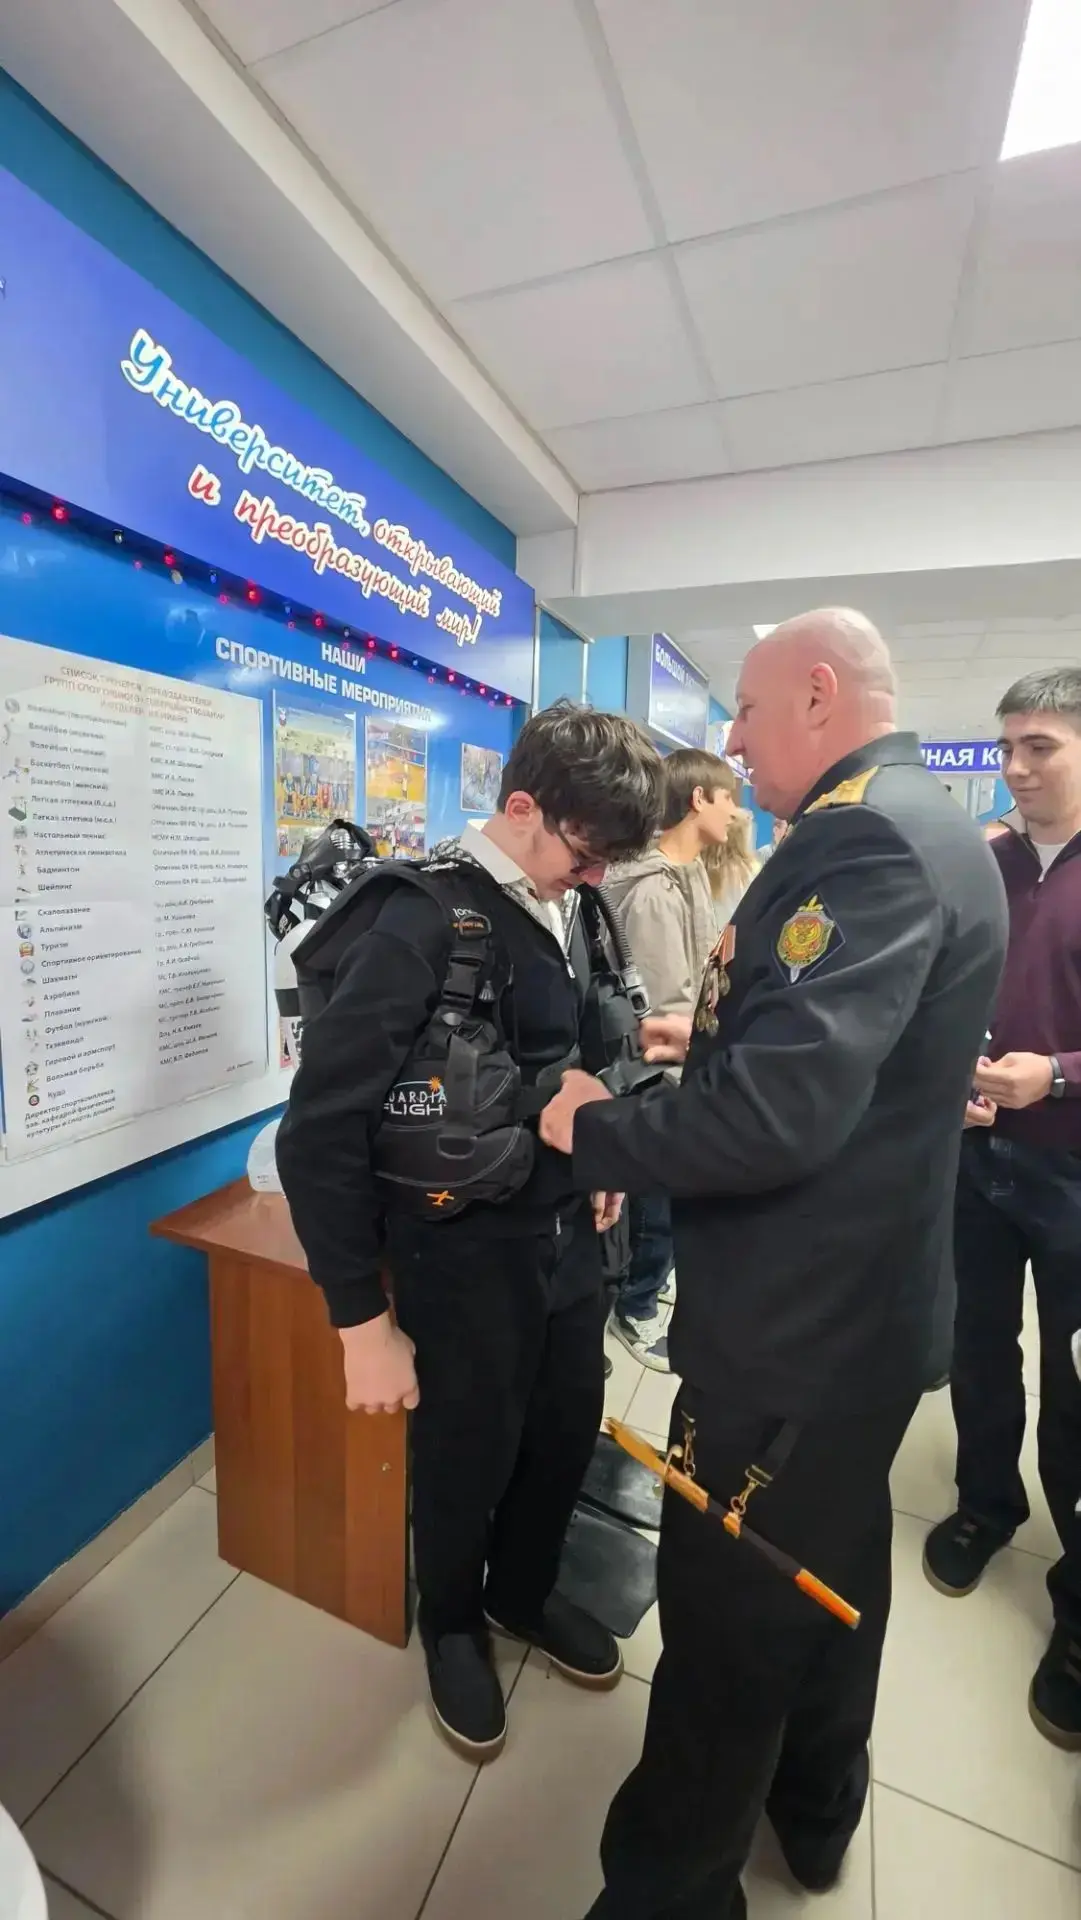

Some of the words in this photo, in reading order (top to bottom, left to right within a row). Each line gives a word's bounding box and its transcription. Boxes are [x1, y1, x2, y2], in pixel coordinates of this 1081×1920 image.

[121, 329, 370, 536] Университет,
[373, 519, 502, 618] открывающий
[188, 464, 221, 505] и
[234, 490, 432, 617] преобразующий
[436, 606, 482, 647] мир!
[321, 642, 366, 675] НАШИ
[215, 637, 337, 695] СПОРТИВНЫЕ
[341, 680, 432, 722] МЕРОПРИЯТИЯ
[36, 866, 80, 874] Бадминтон
[37, 907, 91, 916] Скалолазание
[40, 924, 83, 933] Альпинизм
[41, 942, 69, 952] Туризм
[42, 974, 78, 984] Шахматы
[43, 990, 80, 1001] Аэробика
[44, 1006, 81, 1018] Плавание
[45, 1024, 73, 1034] Футбол
[83, 1043, 116, 1057] армспорт
[46, 1069, 78, 1082] Вольная
[78, 1062, 104, 1074] борьба
[388, 1089, 447, 1103] UARDIA
[383, 1103, 447, 1116] FLIGH
